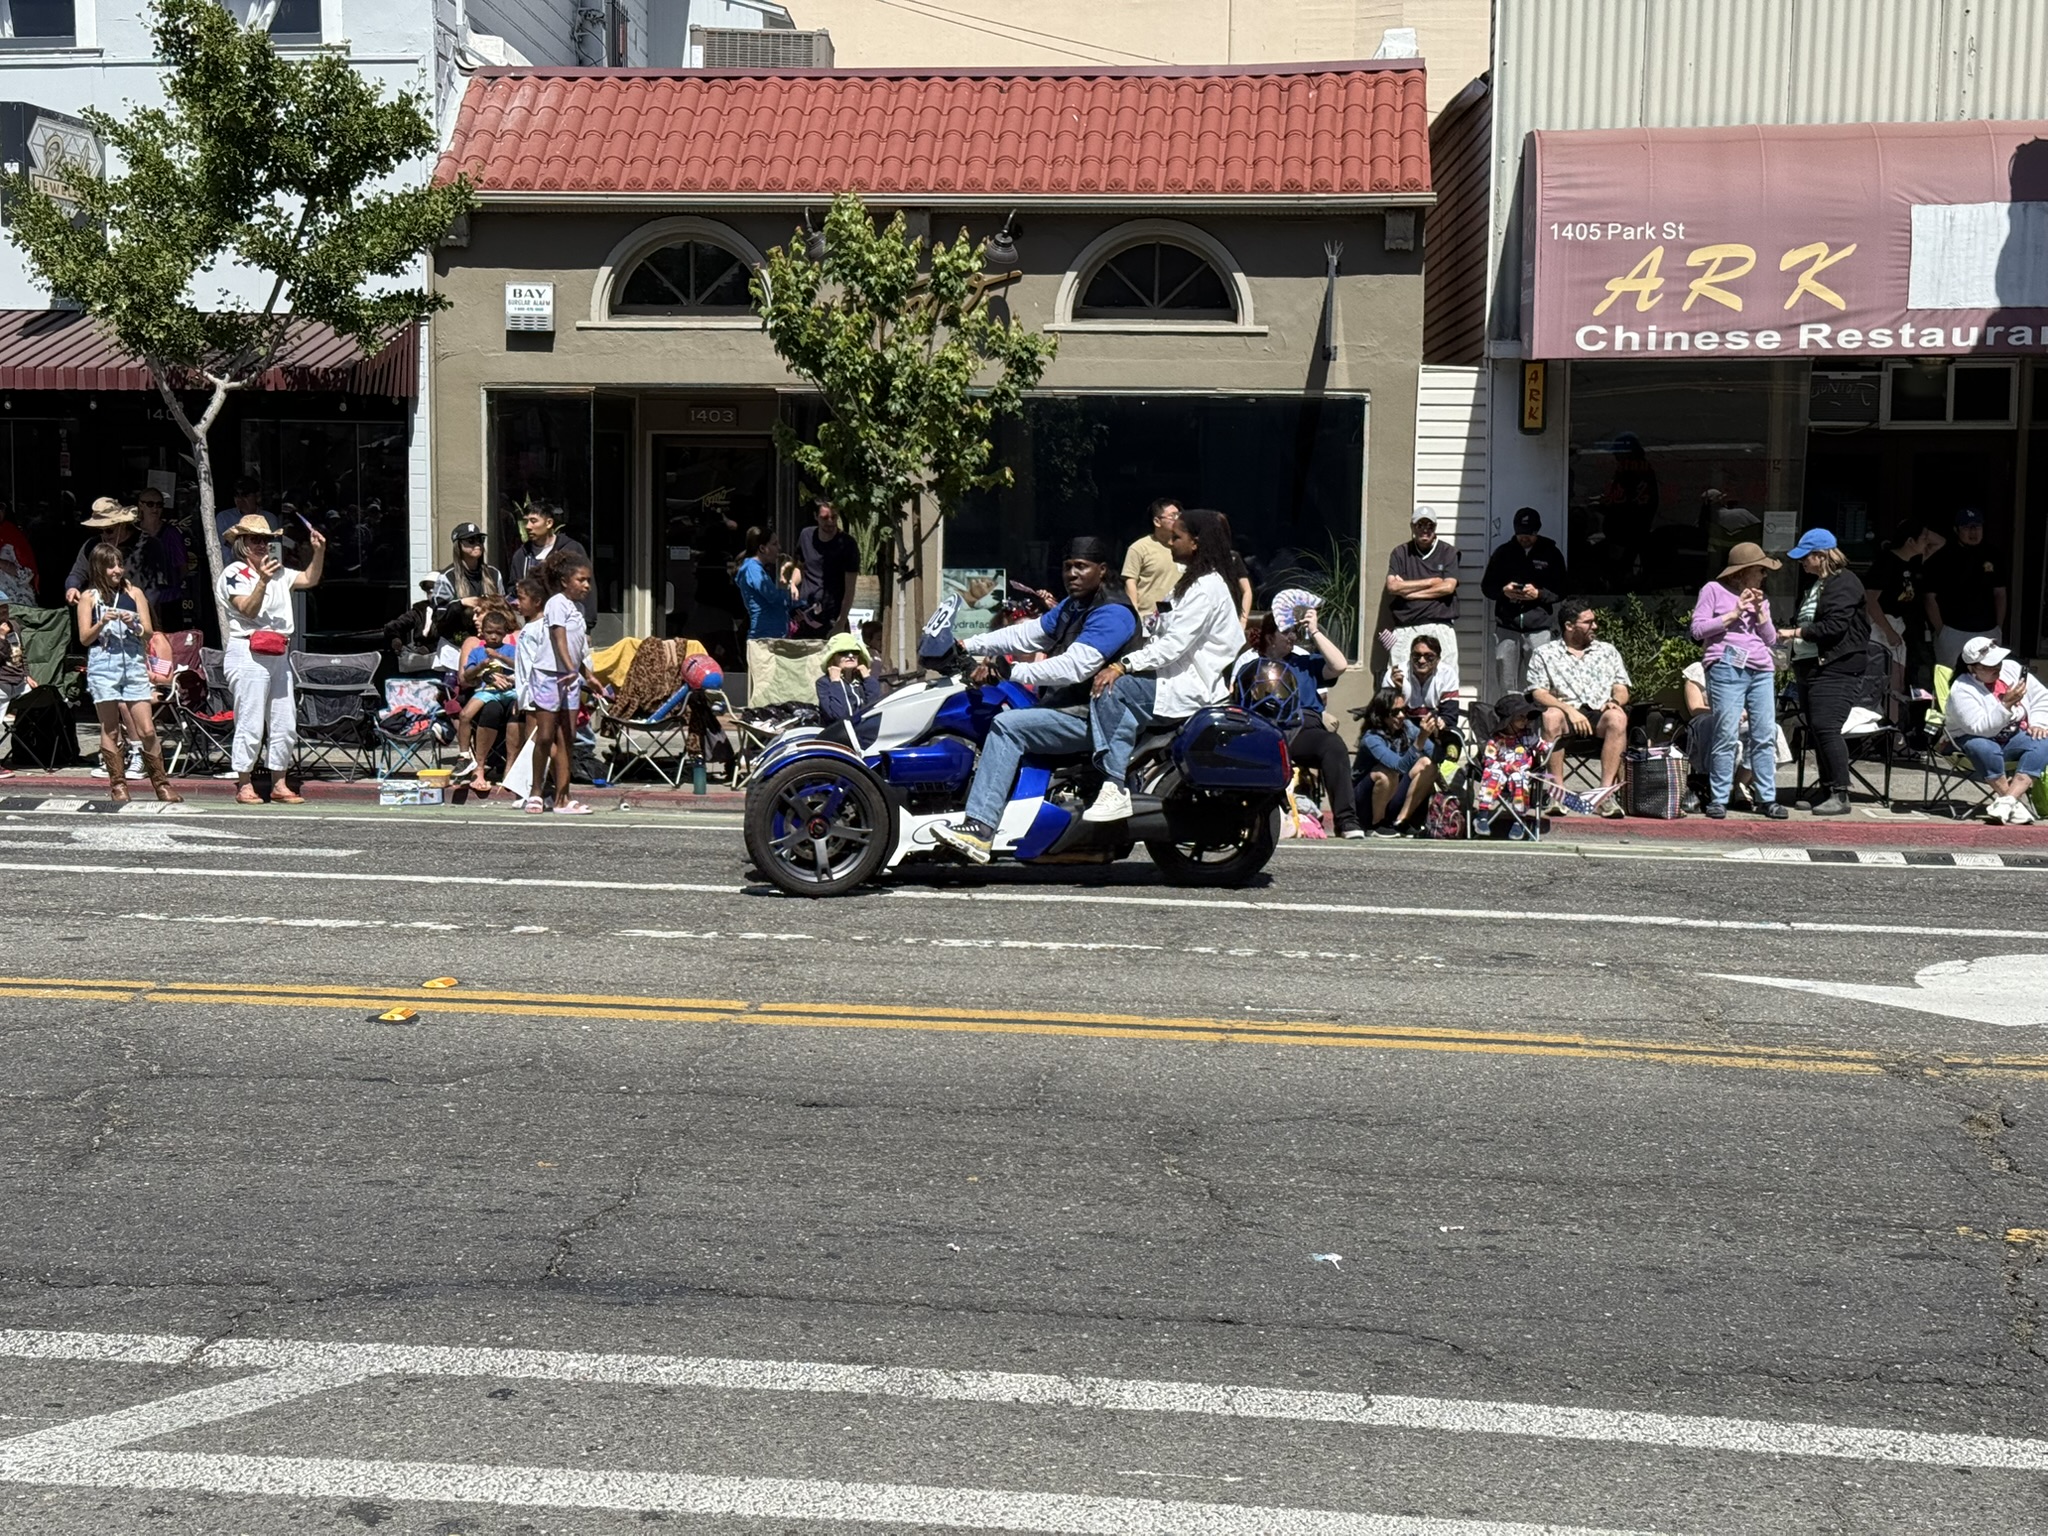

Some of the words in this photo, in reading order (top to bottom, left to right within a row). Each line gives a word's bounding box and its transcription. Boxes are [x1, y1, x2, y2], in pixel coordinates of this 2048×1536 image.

[1550, 222, 1601, 240] 1405
[1607, 221, 1656, 240] Park
[1662, 221, 1685, 240] St
[513, 288, 546, 298] BAY
[1575, 325, 1781, 351] Chinese
[1527, 369, 1541, 421] ARK
[690, 409, 735, 423] 1403
